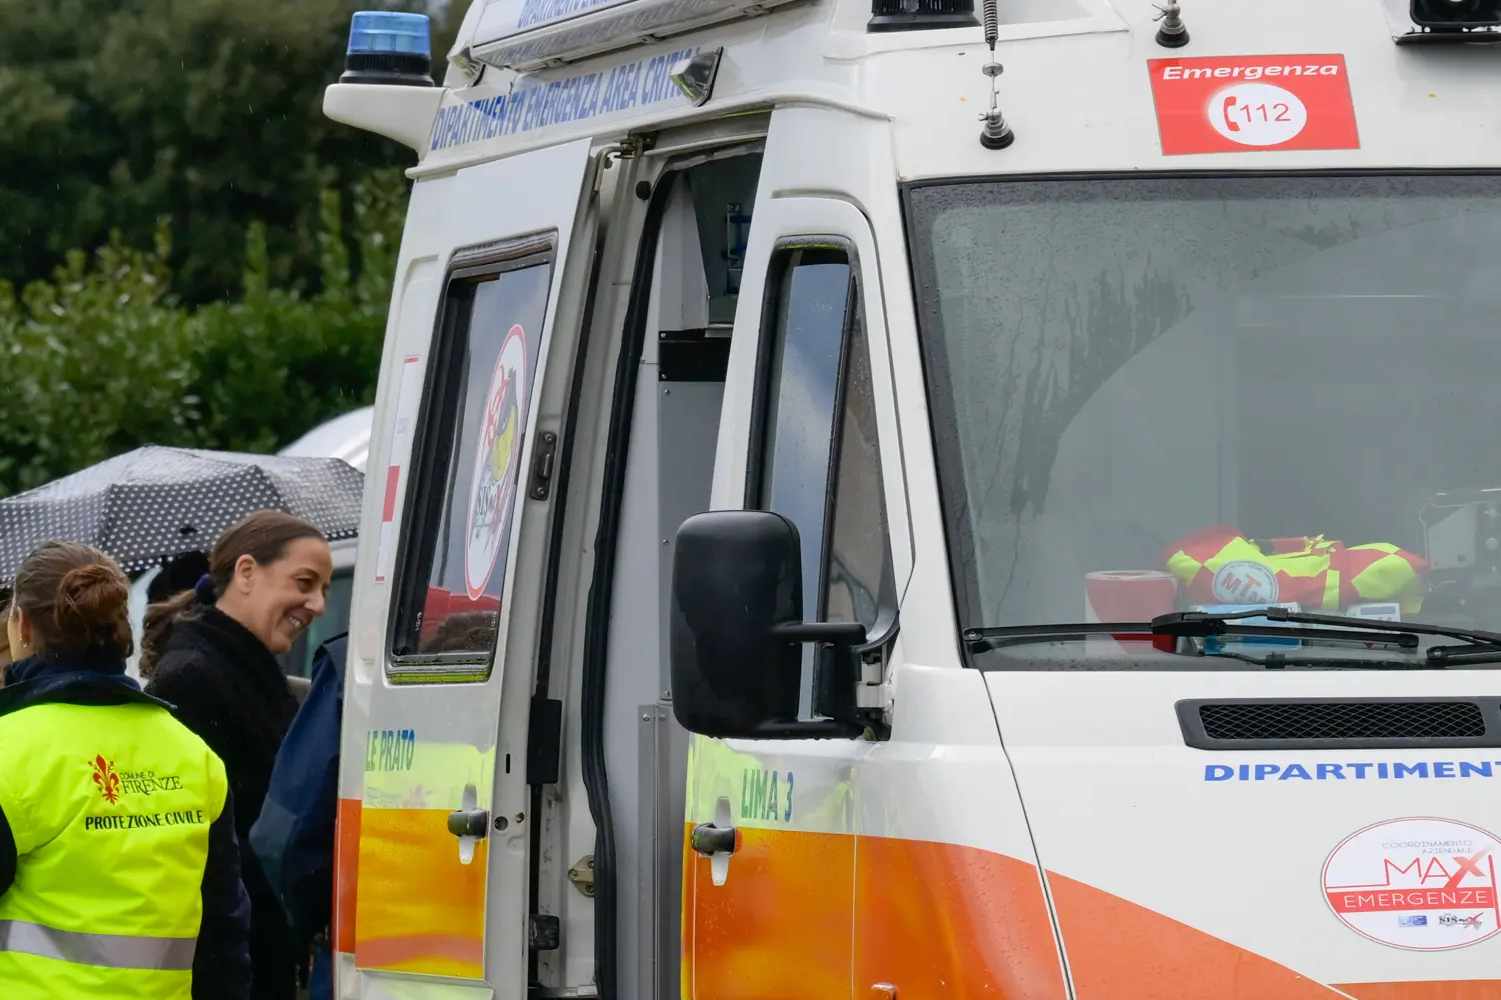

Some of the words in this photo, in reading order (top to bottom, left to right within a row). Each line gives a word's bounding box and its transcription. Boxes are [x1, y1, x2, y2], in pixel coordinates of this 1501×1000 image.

[1163, 64, 1338, 80] Emergenza
[431, 88, 524, 150] DIPARTIMENTO
[522, 71, 604, 132] EMERGENZA
[600, 60, 643, 112] AREA
[642, 46, 701, 105] CRITI
[1240, 103, 1291, 123] 112
[379, 728, 415, 771] PRATO
[120, 771, 146, 780] COMUNE
[148, 770, 155, 778] DI
[1204, 760, 1501, 781] DIPARTIMEN
[121, 775, 183, 796] FIRENZE
[741, 768, 778, 821] LIMA
[784, 771, 794, 823] 3
[85, 813, 164, 831] PROTEZIONE
[165, 809, 204, 826] CIVILE
[1381, 839, 1473, 850] COORDINAMENTO
[1383, 846, 1490, 889] MAX
[1343, 889, 1488, 908] EMERGENZE
